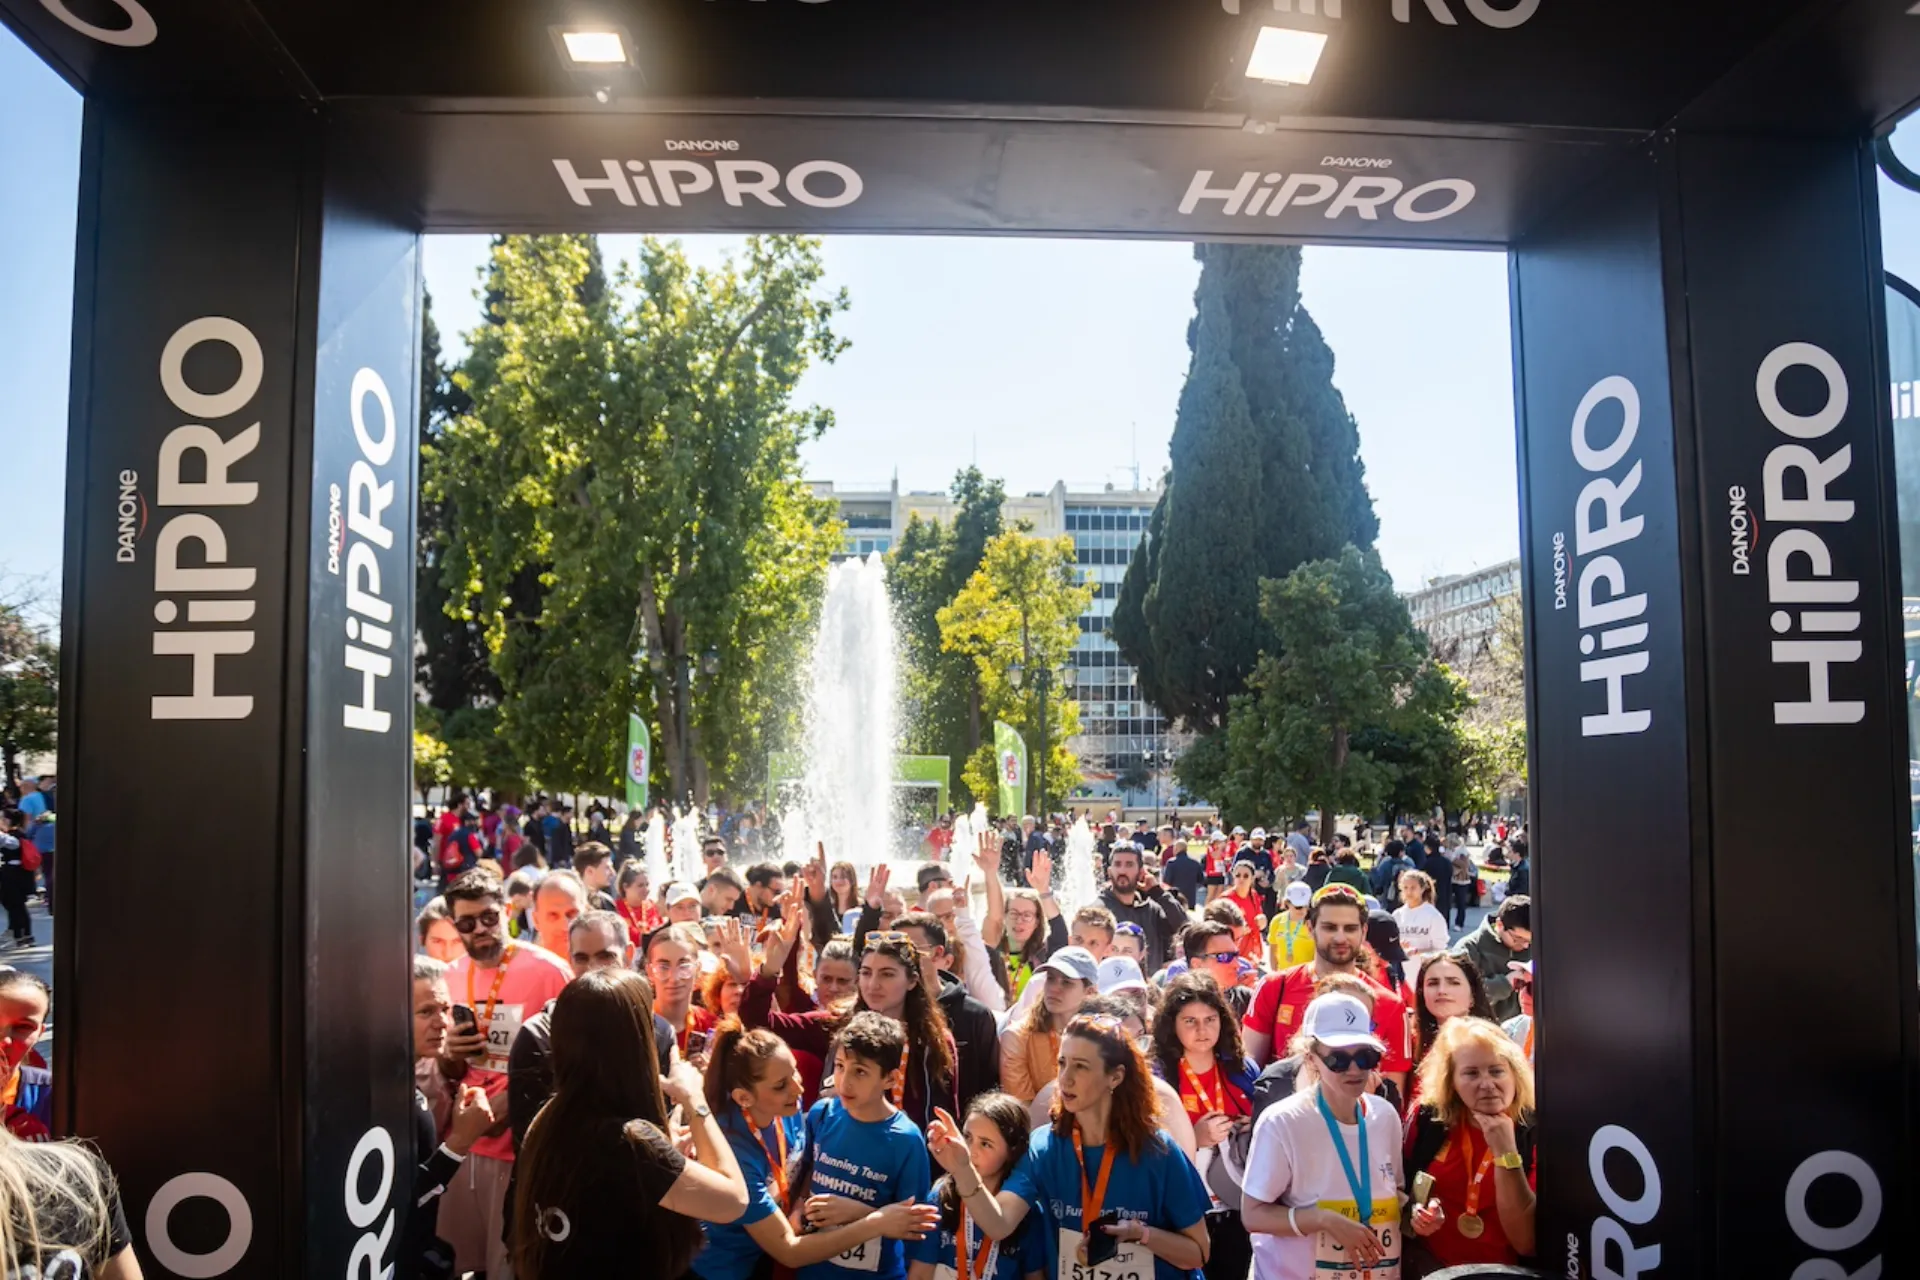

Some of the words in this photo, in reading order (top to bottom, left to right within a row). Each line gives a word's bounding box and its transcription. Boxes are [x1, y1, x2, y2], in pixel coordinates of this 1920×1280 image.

[552, 159, 864, 209] HiPRO
[1178, 169, 1476, 223] HiPRO
[151, 316, 264, 720] HiPRO
[342, 366, 396, 733] HiPRO
[1571, 375, 1652, 737] HiPRO
[1756, 341, 1866, 725] HiPRO
[819, 1152, 859, 1176] Running
[861, 1165, 888, 1182] Team
[1116, 1207, 1148, 1220] Team
